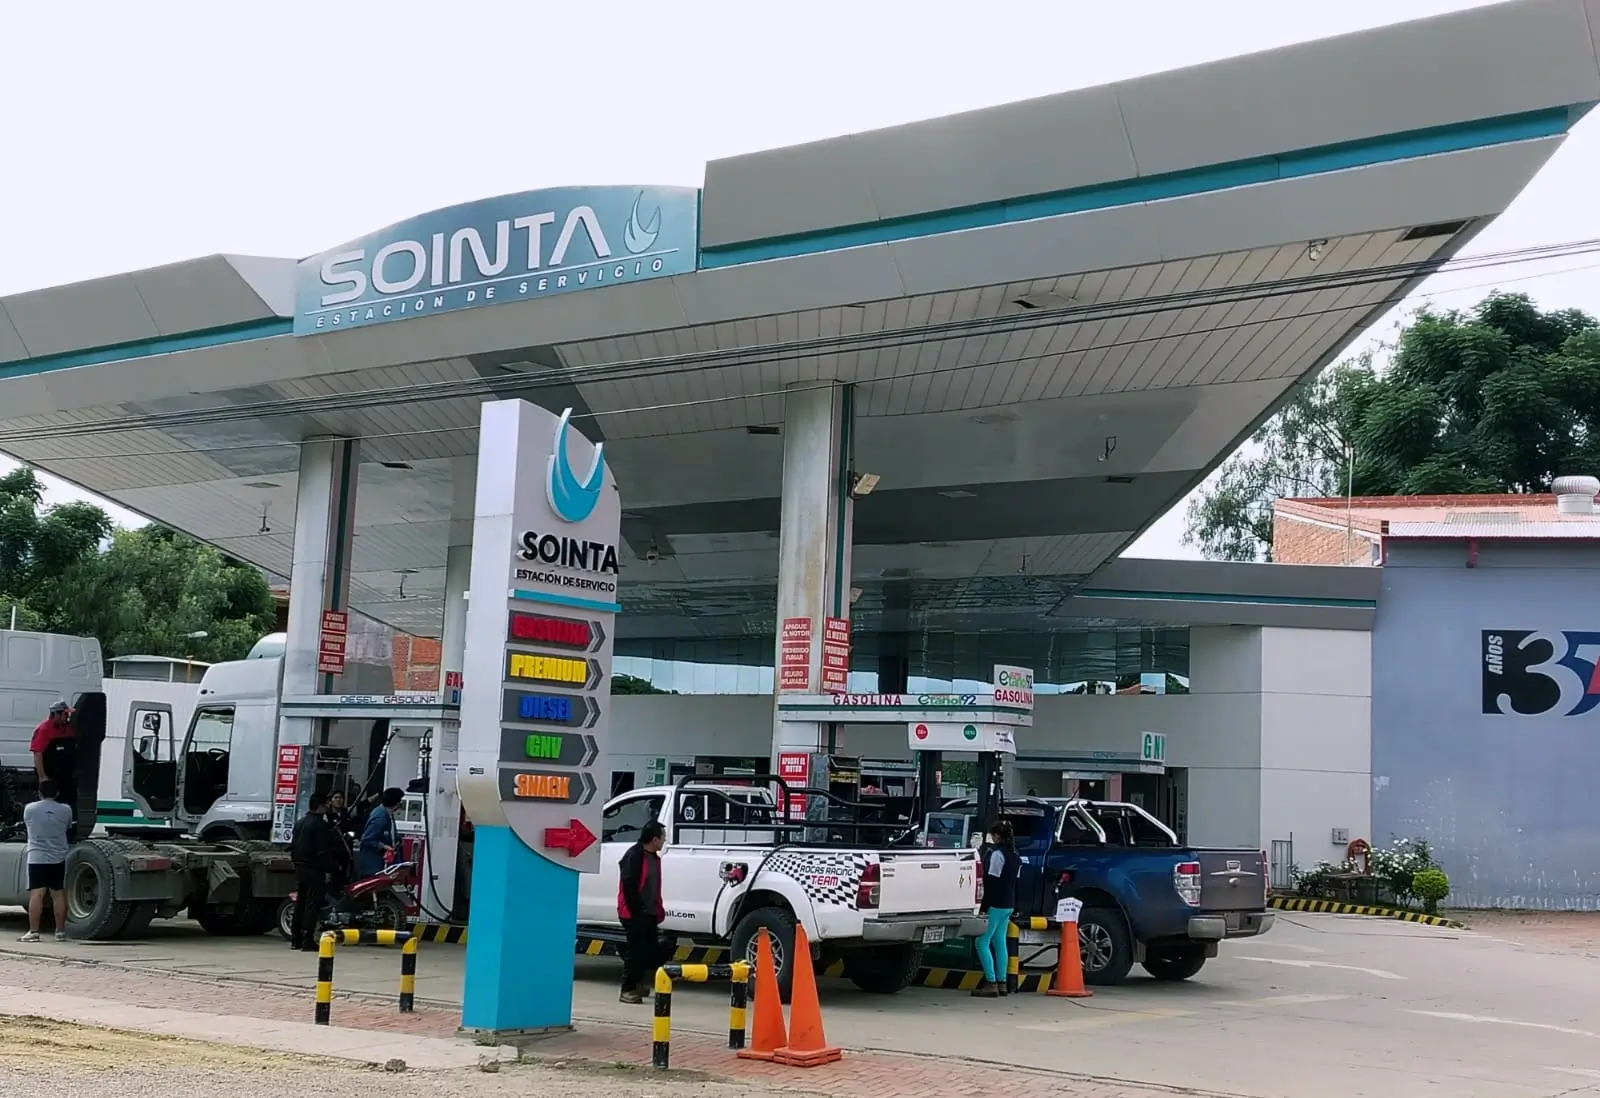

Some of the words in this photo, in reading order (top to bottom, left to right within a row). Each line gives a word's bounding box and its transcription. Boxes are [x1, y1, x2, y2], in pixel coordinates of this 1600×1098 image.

[319, 205, 612, 307] SOINTA
[316, 295, 444, 329] ESTACIÓN
[466, 287, 495, 303] DE
[518, 258, 664, 295] SERVICIO
[519, 531, 620, 575] SOINTA
[515, 569, 561, 584] ESTACIÓN
[562, 576, 575, 587] DE
[575, 578, 616, 592] SERVICIO
[1485, 635, 1503, 675] AÑOS
[510, 654, 587, 683] PREMIUM
[384, 695, 436, 705] GASOLINA
[833, 694, 902, 706] GASOLINA
[995, 689, 1033, 705] GASOLINA
[526, 735, 562, 758] GNV
[514, 773, 570, 799] SNACK
[811, 875, 839, 886] TEAM
